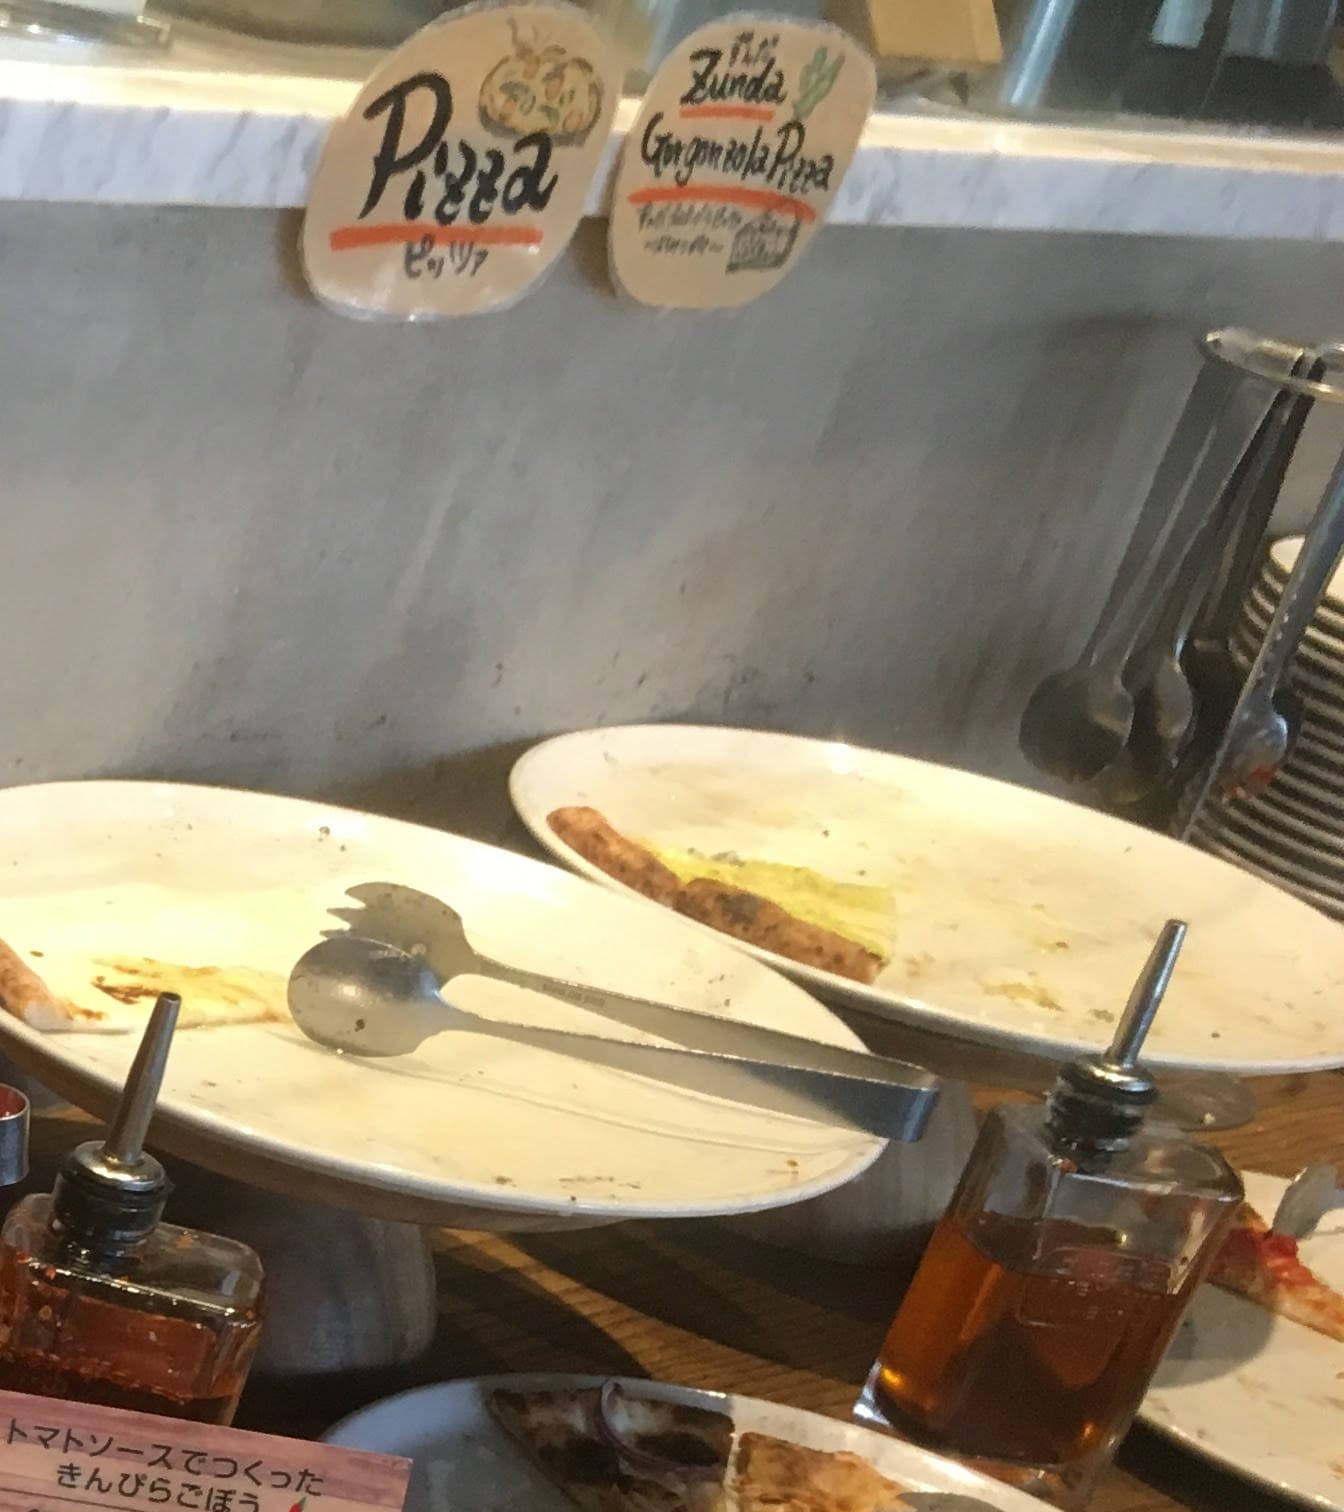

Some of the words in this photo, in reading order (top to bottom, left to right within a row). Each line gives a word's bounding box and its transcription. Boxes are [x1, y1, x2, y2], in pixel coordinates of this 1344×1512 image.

[680, 47, 788, 105] Zunda
[358, 71, 559, 226] Pizza
[6, 1418, 325, 1497] トマトソースでつくった
